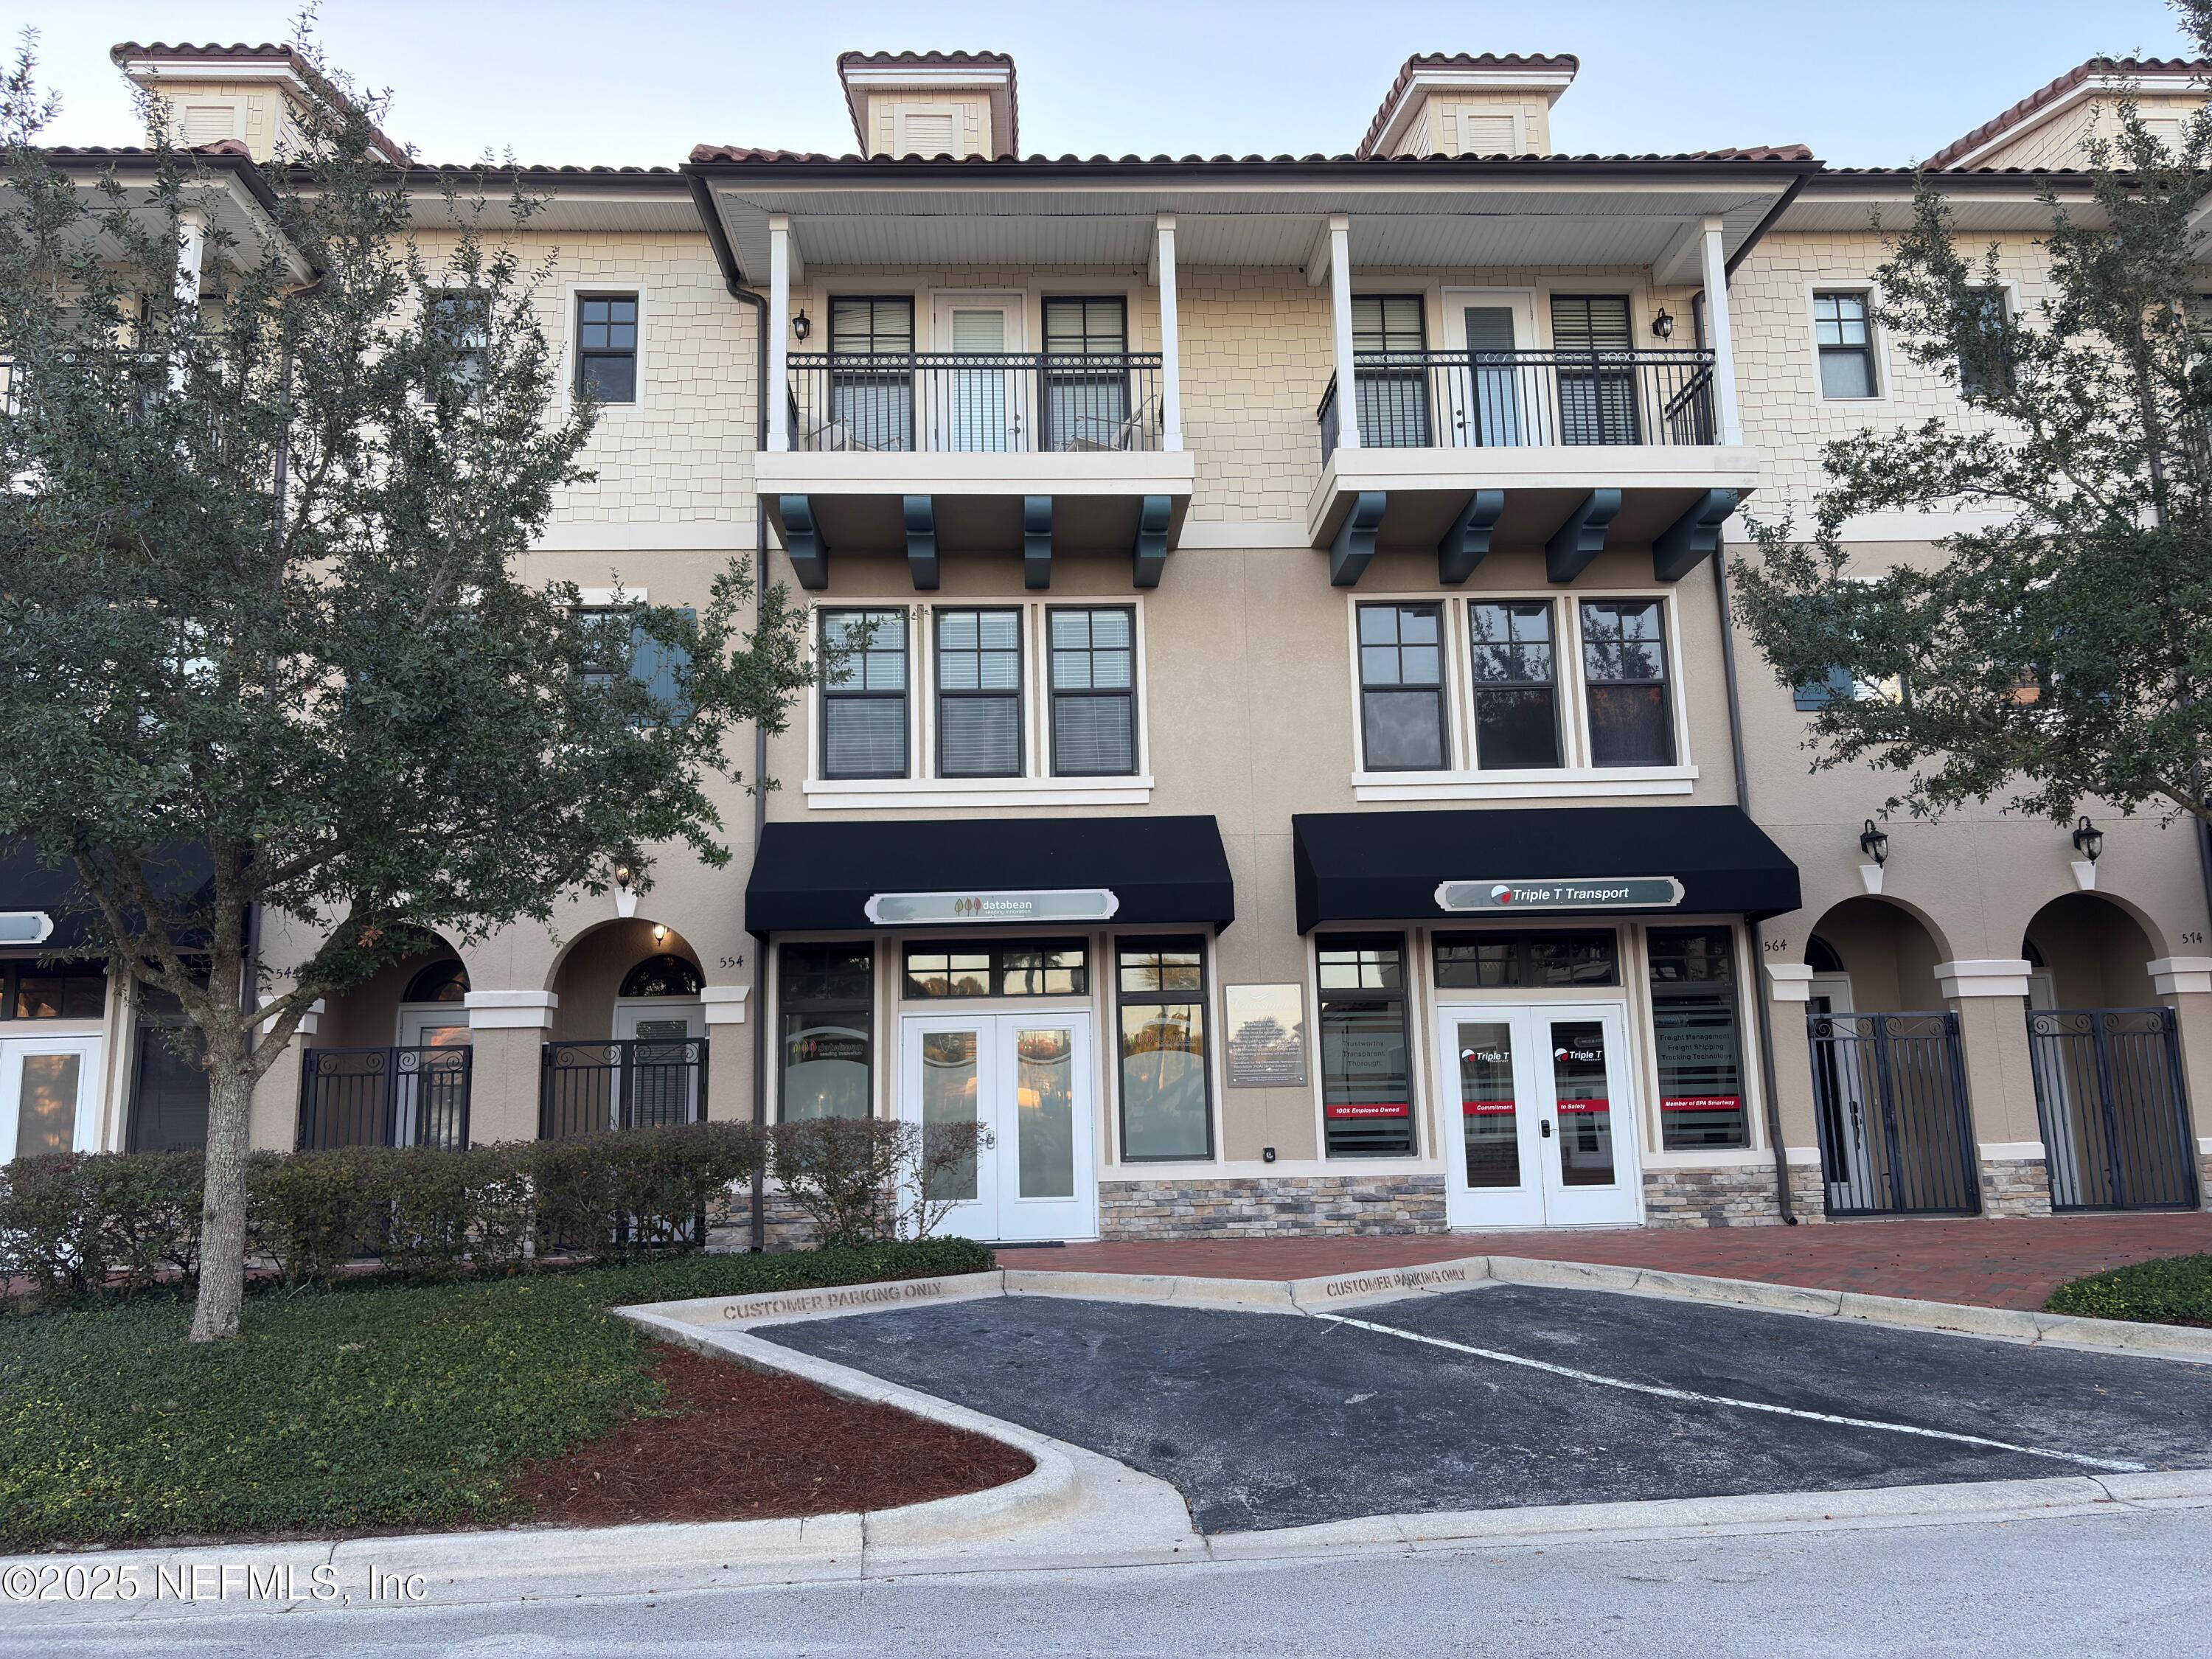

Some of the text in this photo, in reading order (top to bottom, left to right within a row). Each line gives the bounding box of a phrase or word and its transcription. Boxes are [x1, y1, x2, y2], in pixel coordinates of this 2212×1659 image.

[1513, 887, 1630, 902] Triple T Transport
[983, 900, 1032, 910] databean
[2183, 932, 2203, 945] 514
[1764, 939, 1787, 952] 564
[720, 956, 744, 968] 554
[1476, 1051, 1501, 1062] Triple
[1569, 1051, 1593, 1060] Triple
[1326, 1268, 1467, 1297] CUSTOMER PARKING ONLY
[723, 1281, 942, 1320] CUSTOMER PARKING ONLY
